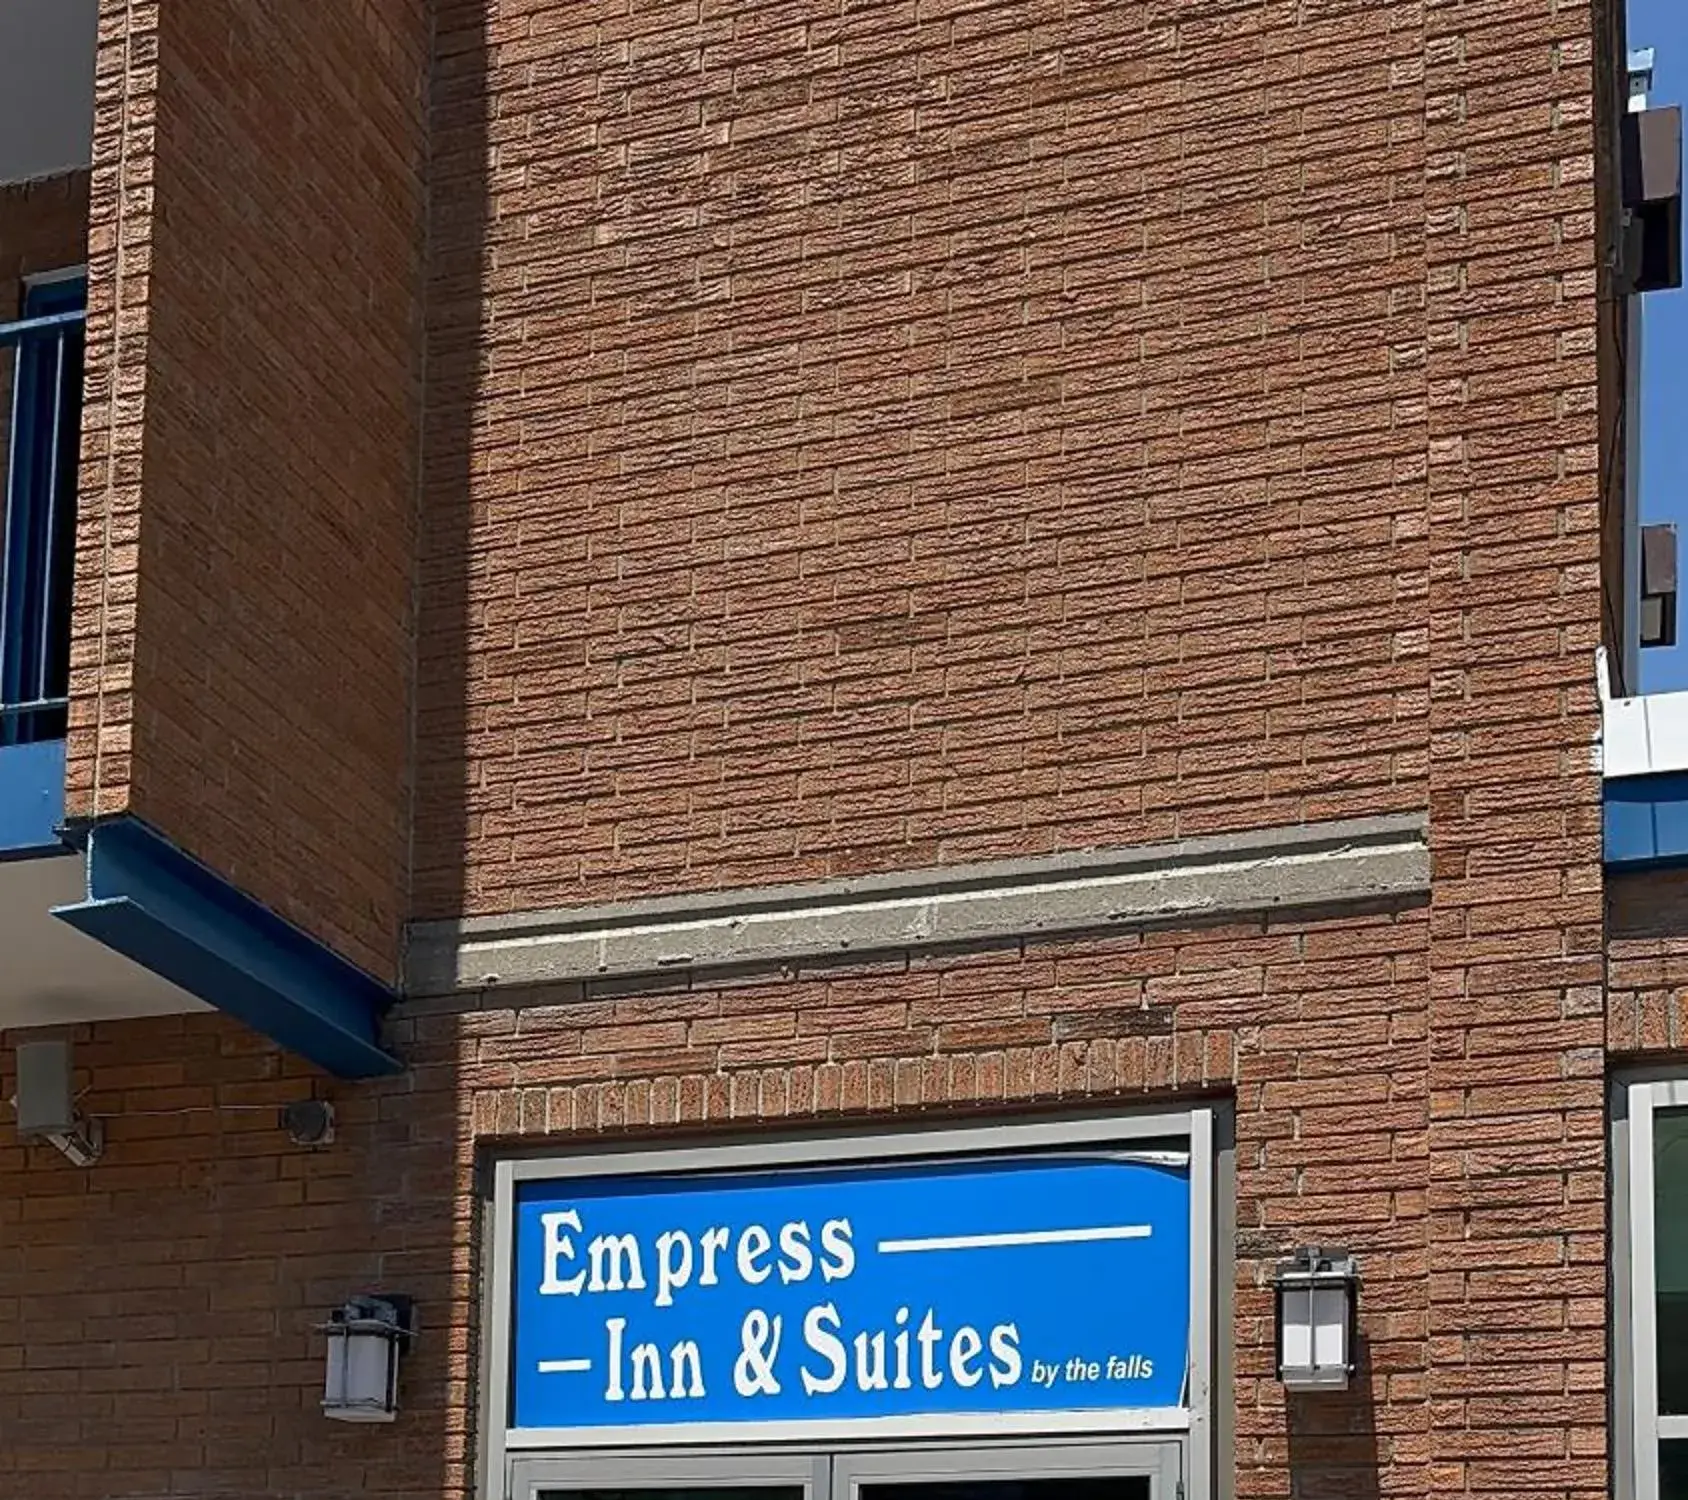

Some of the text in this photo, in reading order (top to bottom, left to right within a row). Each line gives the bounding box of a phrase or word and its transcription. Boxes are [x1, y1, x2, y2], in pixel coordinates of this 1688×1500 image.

[540, 1207, 855, 1306] Empress
[604, 1302, 1153, 1401] Inn & Suites by the falls
